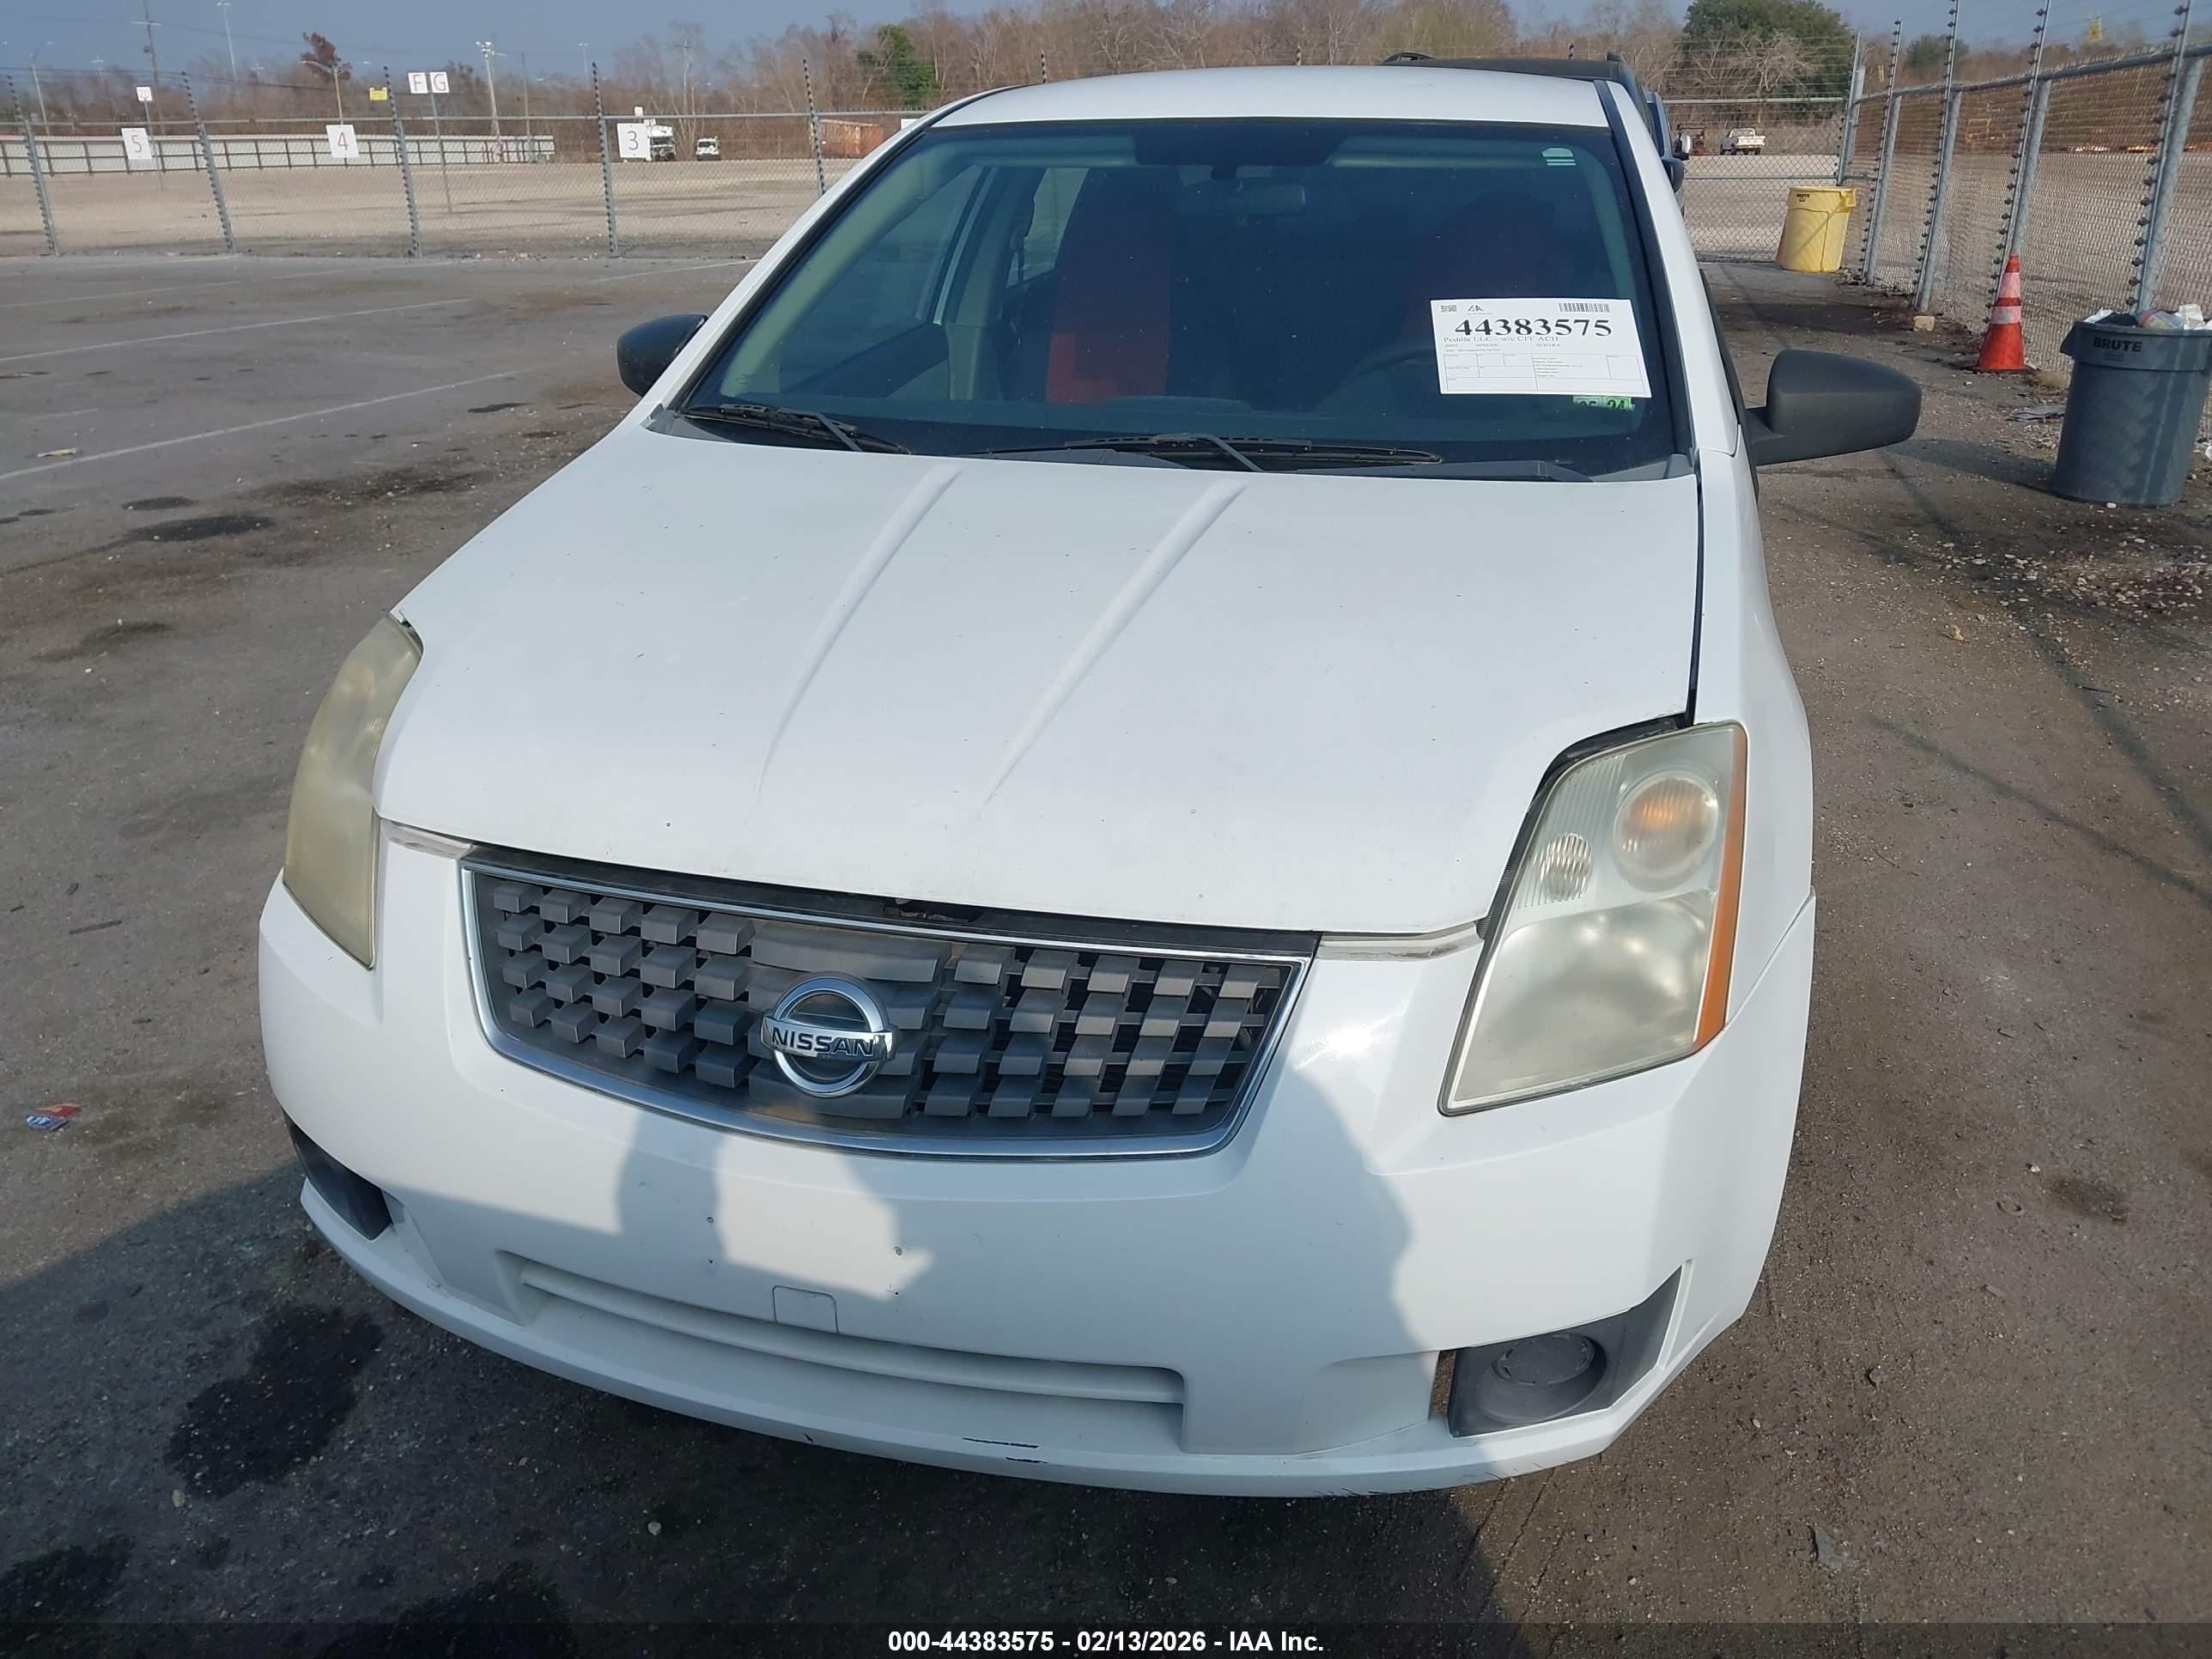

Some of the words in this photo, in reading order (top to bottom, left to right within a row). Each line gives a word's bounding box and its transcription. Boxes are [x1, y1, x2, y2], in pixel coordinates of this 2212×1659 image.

[412, 74, 422, 91] F
[433, 73, 447, 92] G
[131, 134, 142, 153] 5
[337, 131, 349, 151] 4
[627, 130, 639, 151] 3
[1455, 318, 1613, 337] 44383575
[2094, 337, 2143, 352] BRUTE
[771, 1026, 874, 1057] NISSAN
